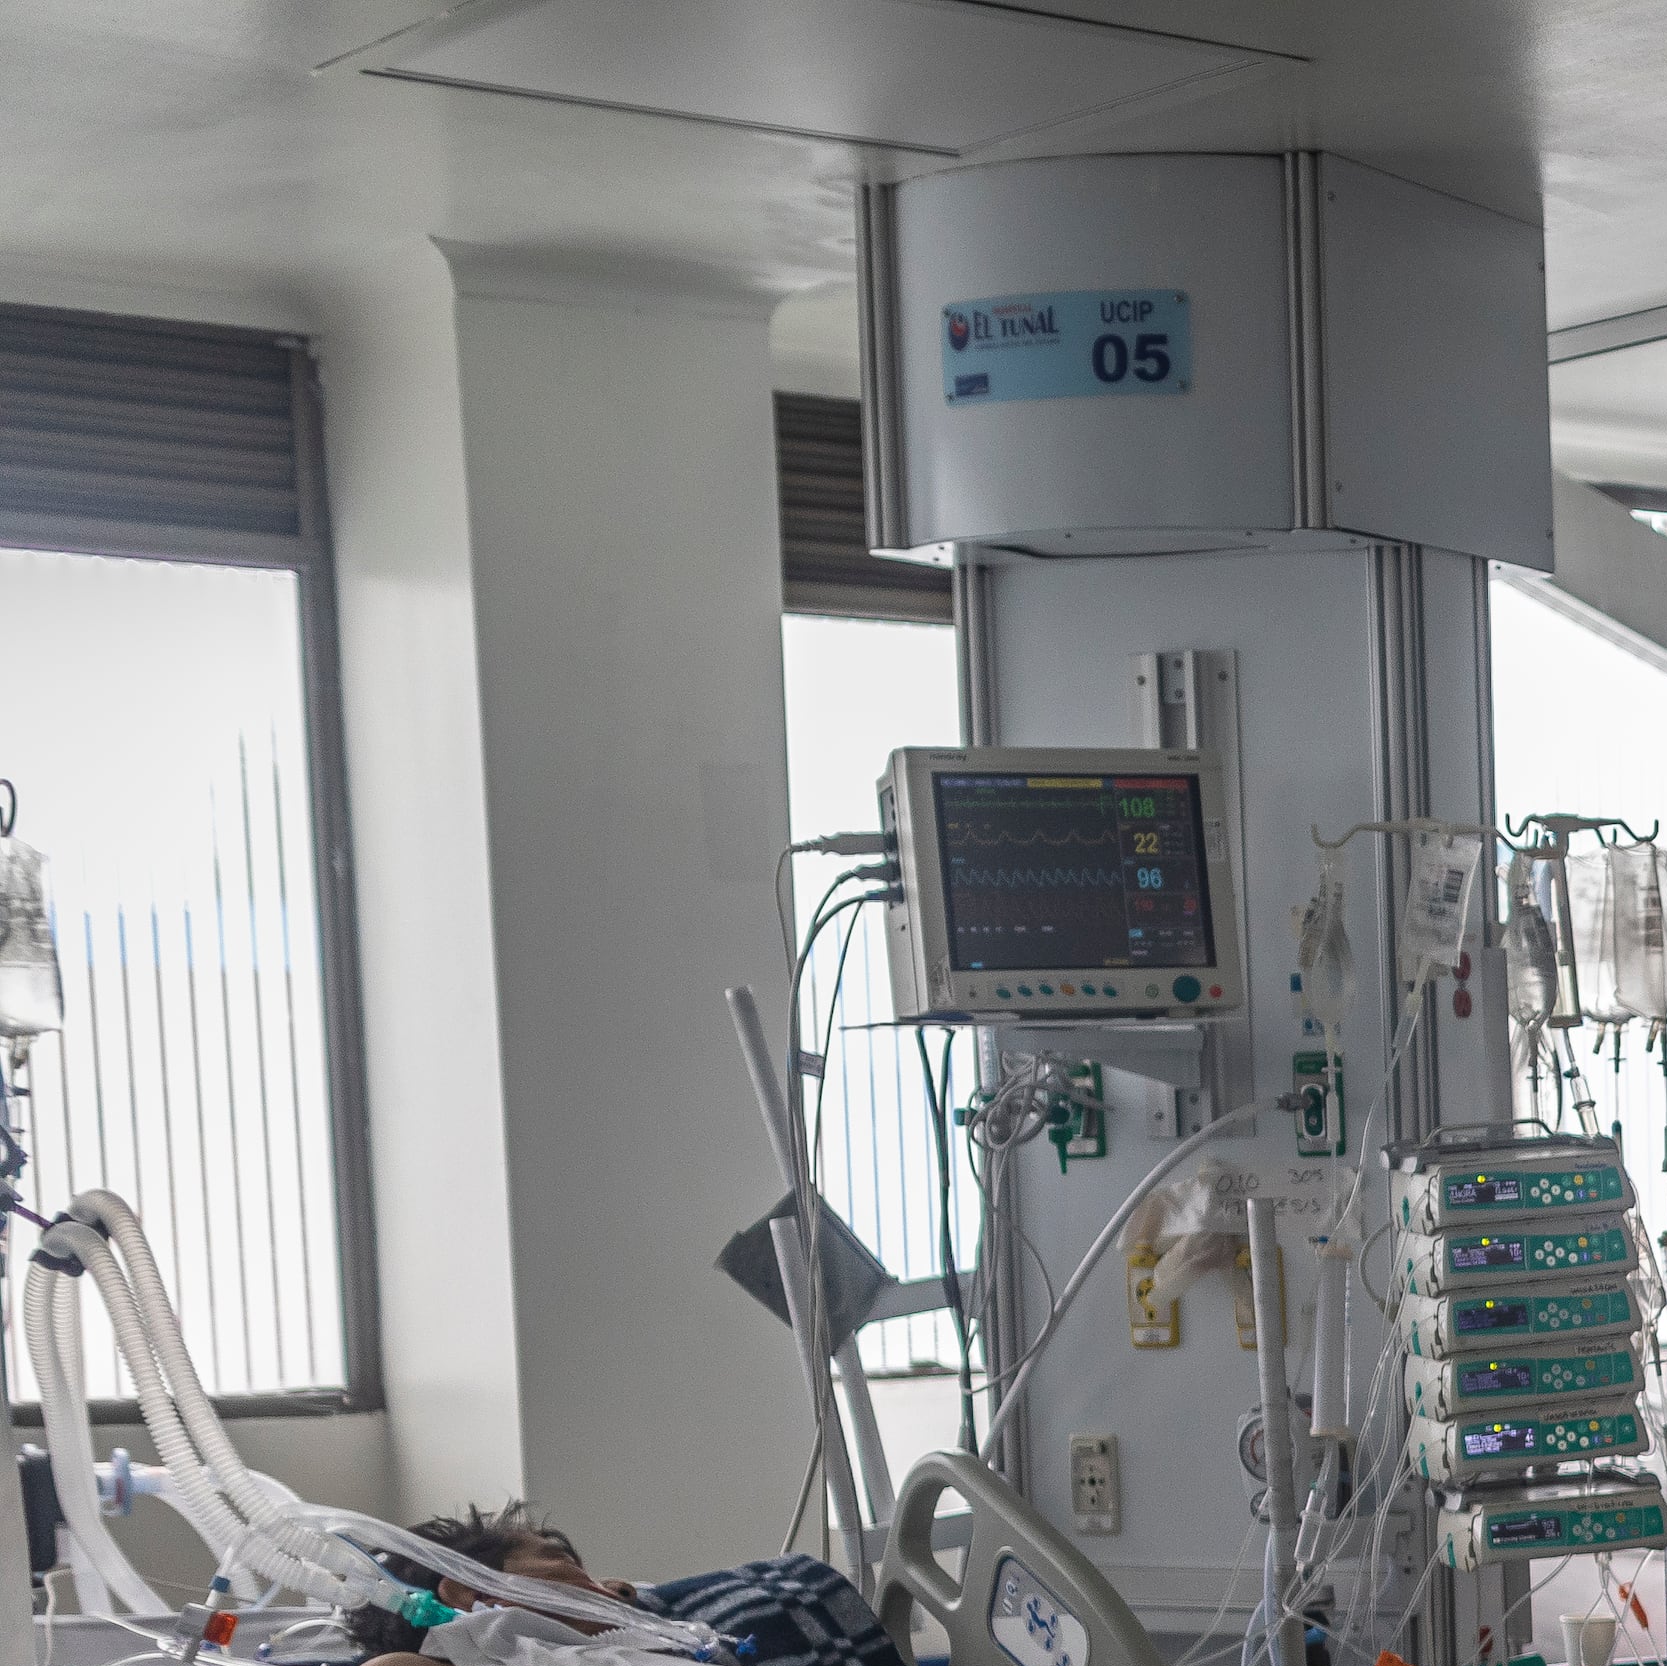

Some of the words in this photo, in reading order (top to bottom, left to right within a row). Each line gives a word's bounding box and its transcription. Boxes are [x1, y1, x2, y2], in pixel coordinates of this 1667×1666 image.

[973, 310, 994, 340] EL
[999, 305, 1060, 337] TUNAL
[1100, 300, 1154, 323] UCIP
[1091, 333, 1171, 384] 05
[1120, 797, 1156, 819] 108
[1133, 832, 1160, 855] 22
[1136, 867, 1163, 889] 96
